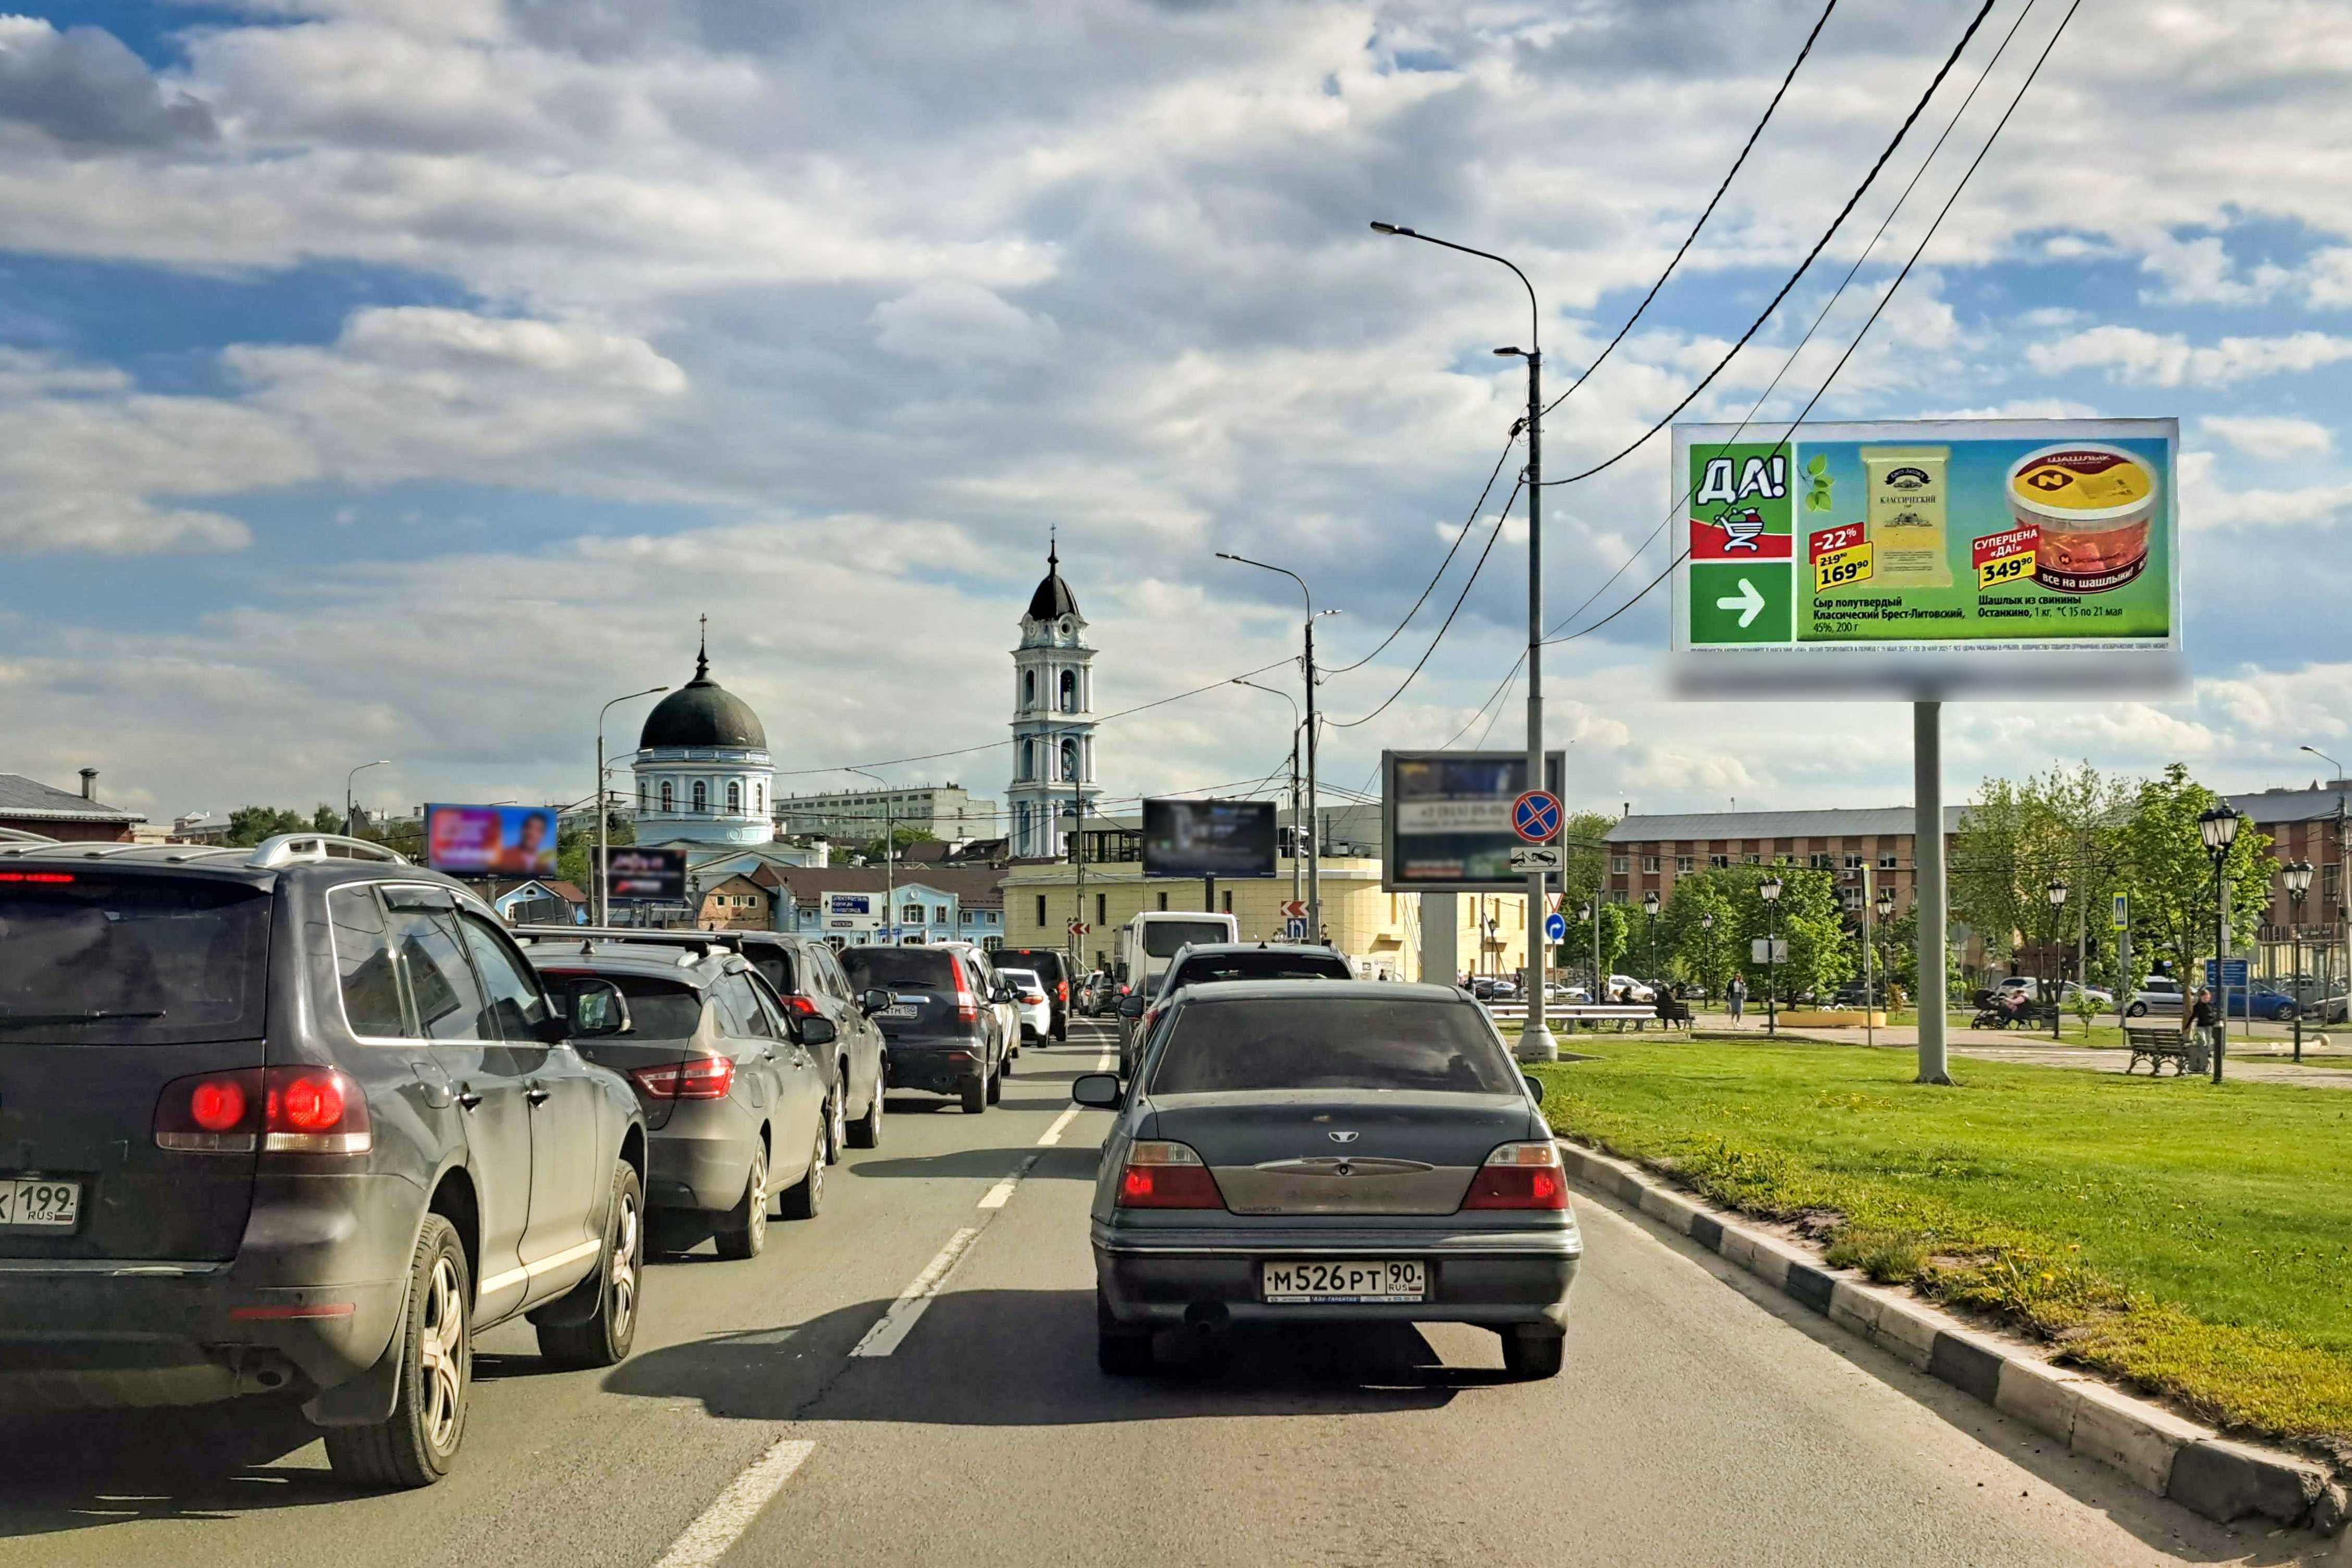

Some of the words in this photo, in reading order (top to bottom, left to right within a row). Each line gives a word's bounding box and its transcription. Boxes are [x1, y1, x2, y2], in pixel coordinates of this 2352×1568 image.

[1696, 455, 1787, 506] ДА!
[1880, 496, 1937, 504] КЛАССИЧЕСКИЙ
[1814, 527, 1856, 550] -22%
[1974, 529, 2038, 550] СУПЕРЦЕНА
[2042, 574, 2060, 585] все
[2062, 577, 2076, 587] на
[1814, 597, 1833, 609] Сыр
[1836, 597, 1902, 609] полутвердый
[1978, 595, 2023, 605] Шашлык
[2038, 596, 2082, 604] свинины
[1814, 609, 1879, 620] Классический
[1978, 607, 2033, 618] Останкино,
[2035, 607, 2039, 617] 1
[2069, 607, 2078, 616] 15
[2093, 607, 2103, 616] 21
[1837, 622, 1852, 632] 200
[19, 1186, 70, 1212] 199
[28, 1212, 53, 1220] RUS
[1274, 1265, 1381, 1291] М526РТ
[1389, 1264, 1415, 1283] 90
